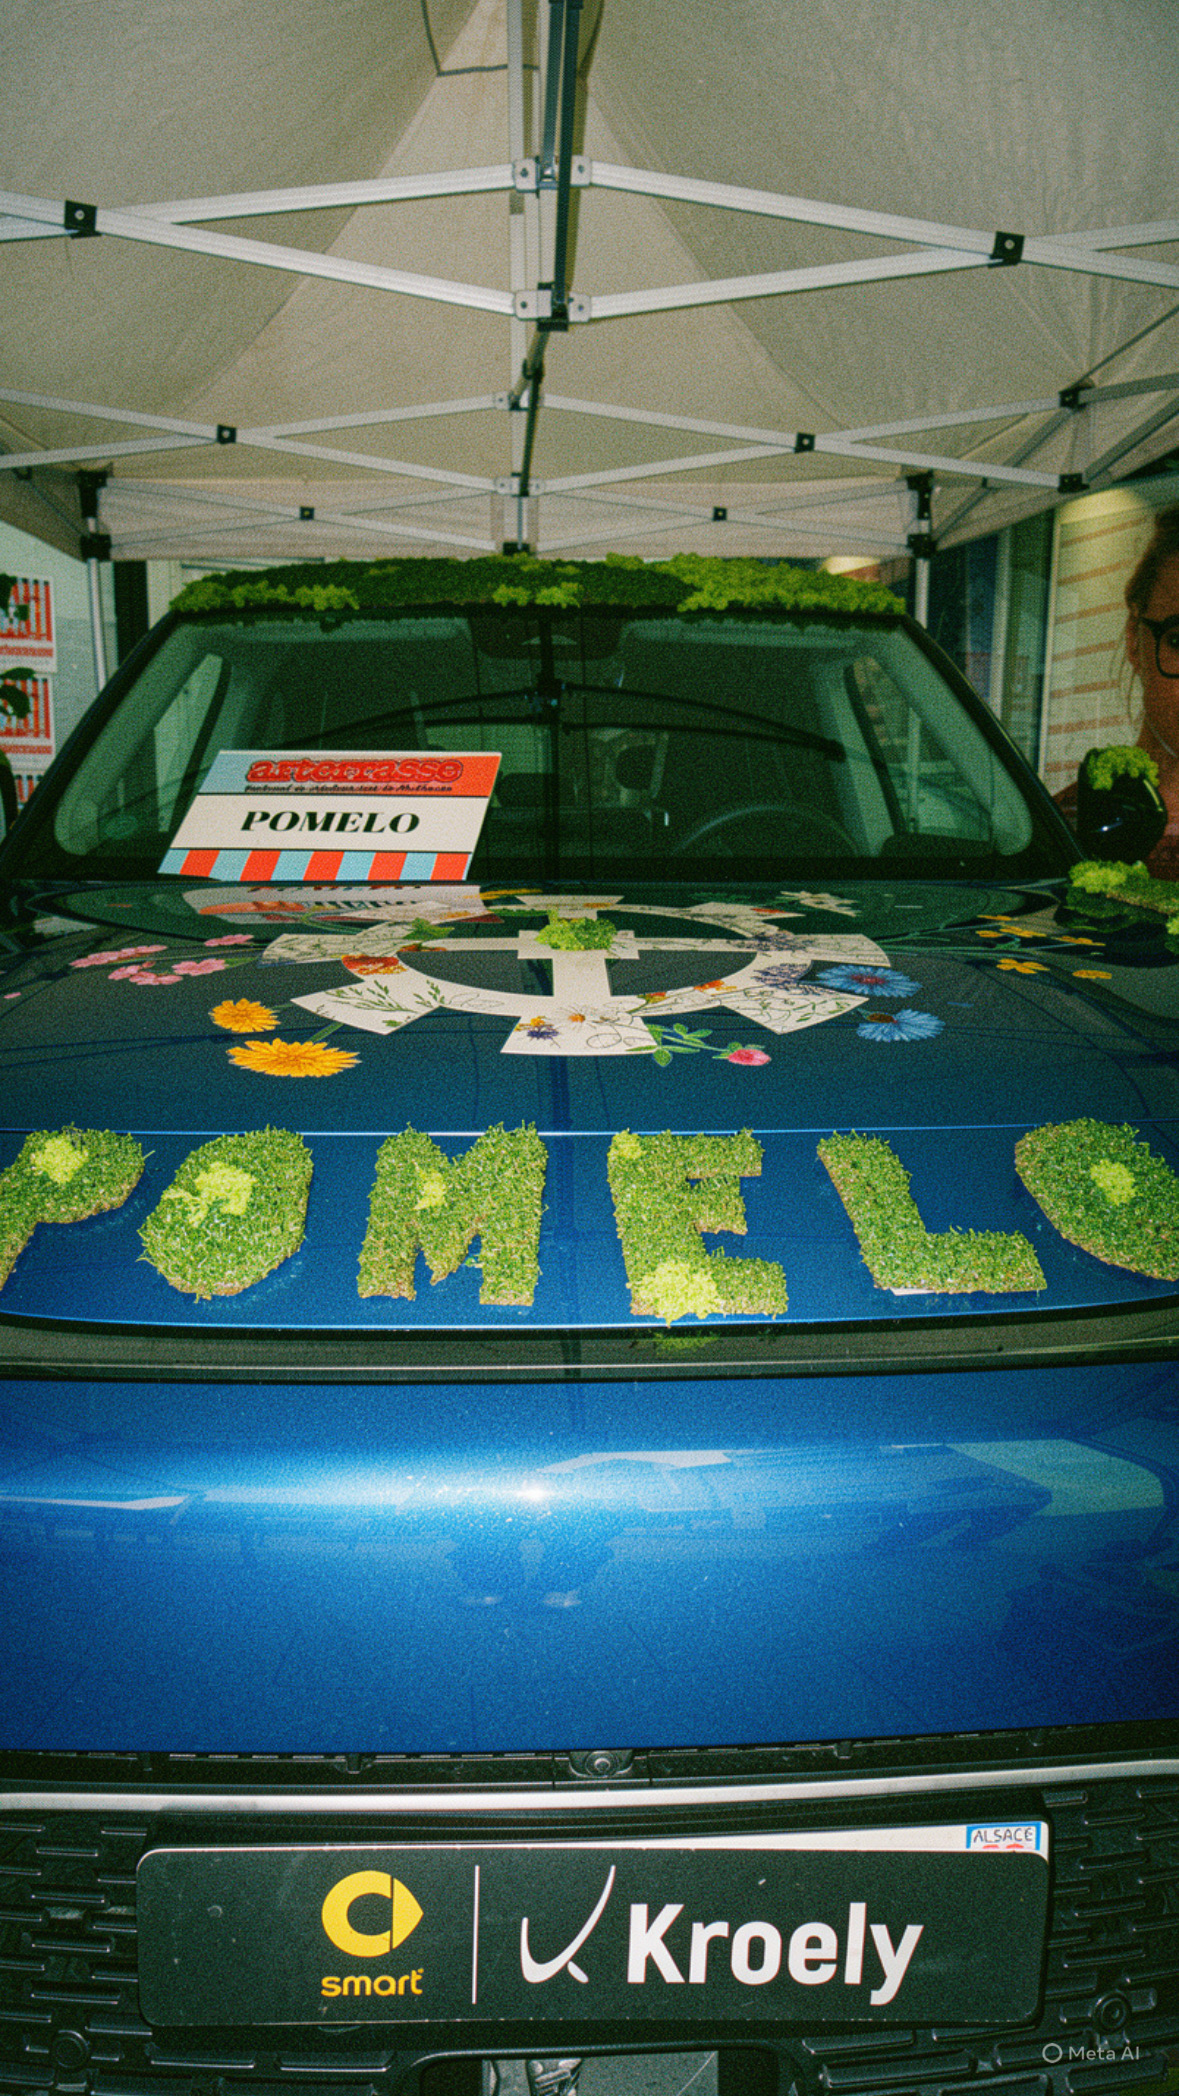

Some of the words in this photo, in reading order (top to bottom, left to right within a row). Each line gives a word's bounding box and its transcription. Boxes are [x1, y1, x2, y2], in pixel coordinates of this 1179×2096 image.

[241, 811, 419, 833] POMELO
[0, 1117, 1179, 1324] POMELO
[973, 1827, 1033, 1843] ALSACE
[626, 1902, 924, 2006] Kroely
[321, 1969, 424, 1997] smart
